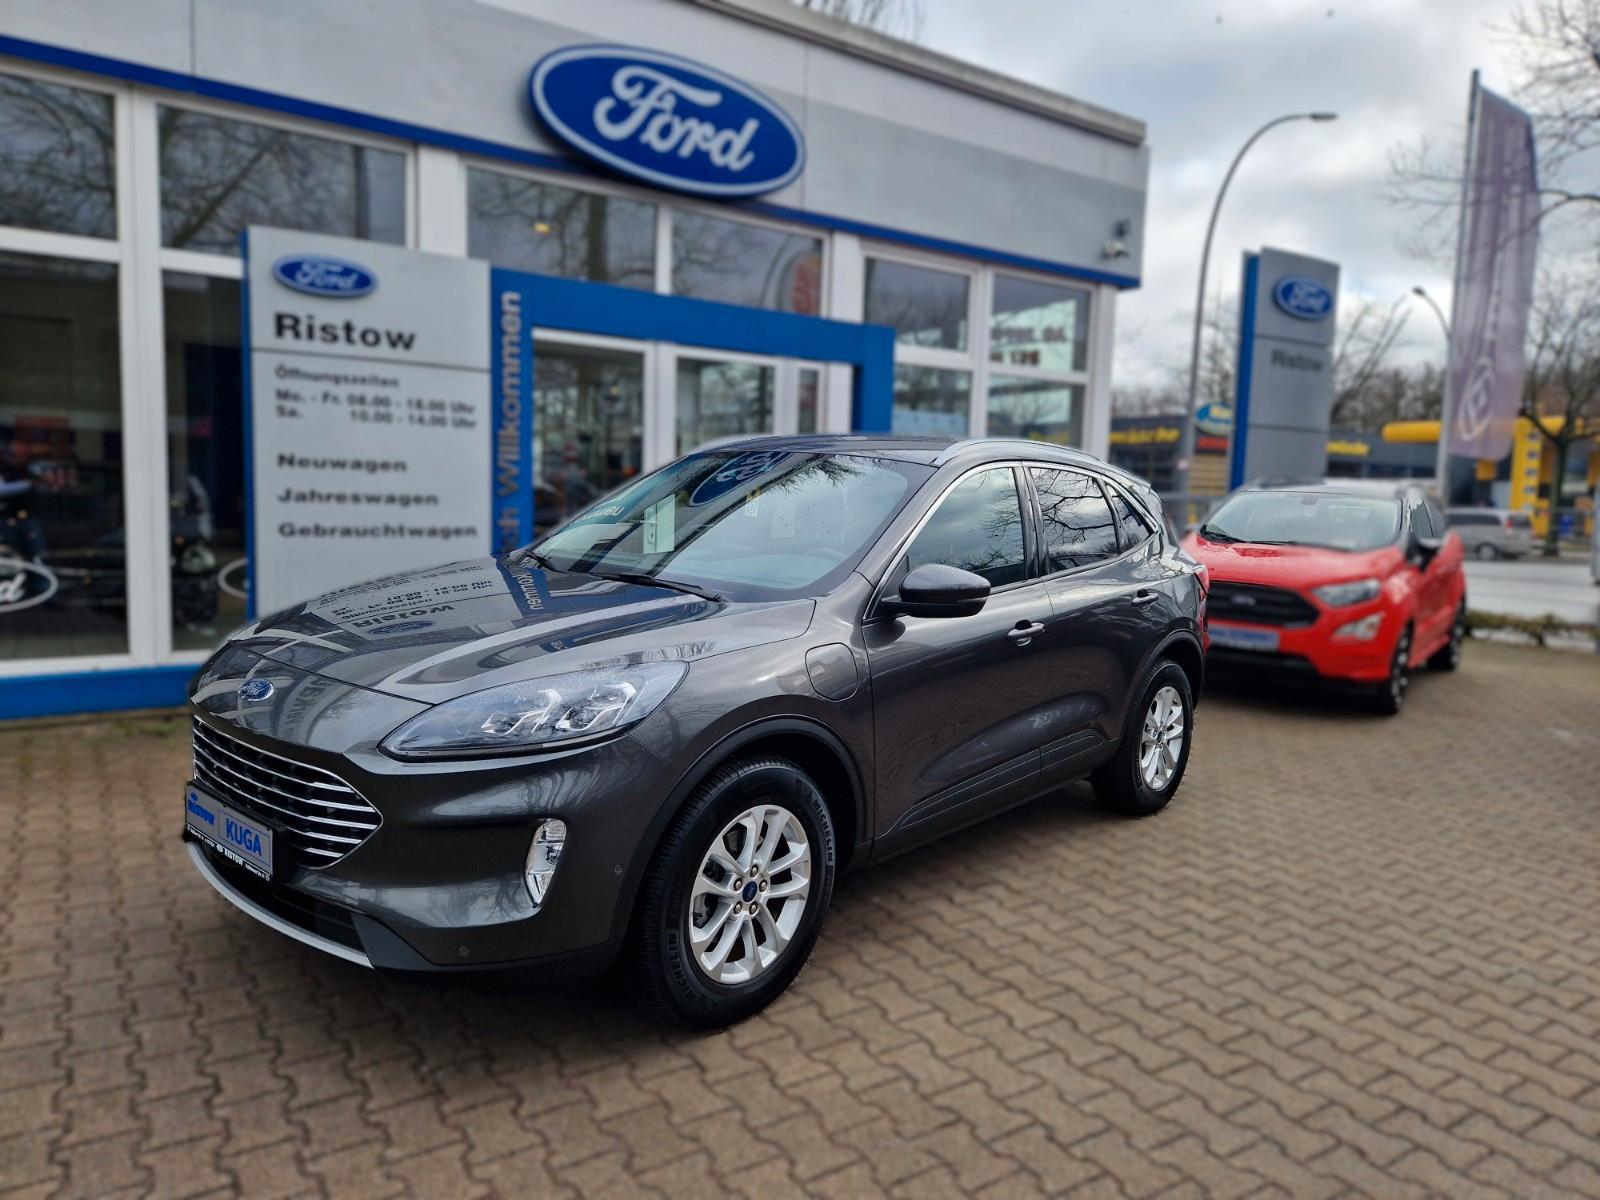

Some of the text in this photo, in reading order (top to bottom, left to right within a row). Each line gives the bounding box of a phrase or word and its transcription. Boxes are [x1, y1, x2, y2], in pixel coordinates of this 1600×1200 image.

[592, 65, 760, 172] Ford
[295, 260, 358, 290] Ford
[274, 312, 416, 350] Ristow
[498, 290, 523, 497] Willkommen
[277, 453, 407, 475] Neuwagen
[277, 487, 439, 506] Jahreswagen
[277, 522, 478, 541] Gebrauchtwagen
[226, 817, 262, 857] KUGA
[812, 800, 833, 863] MICHELIN
